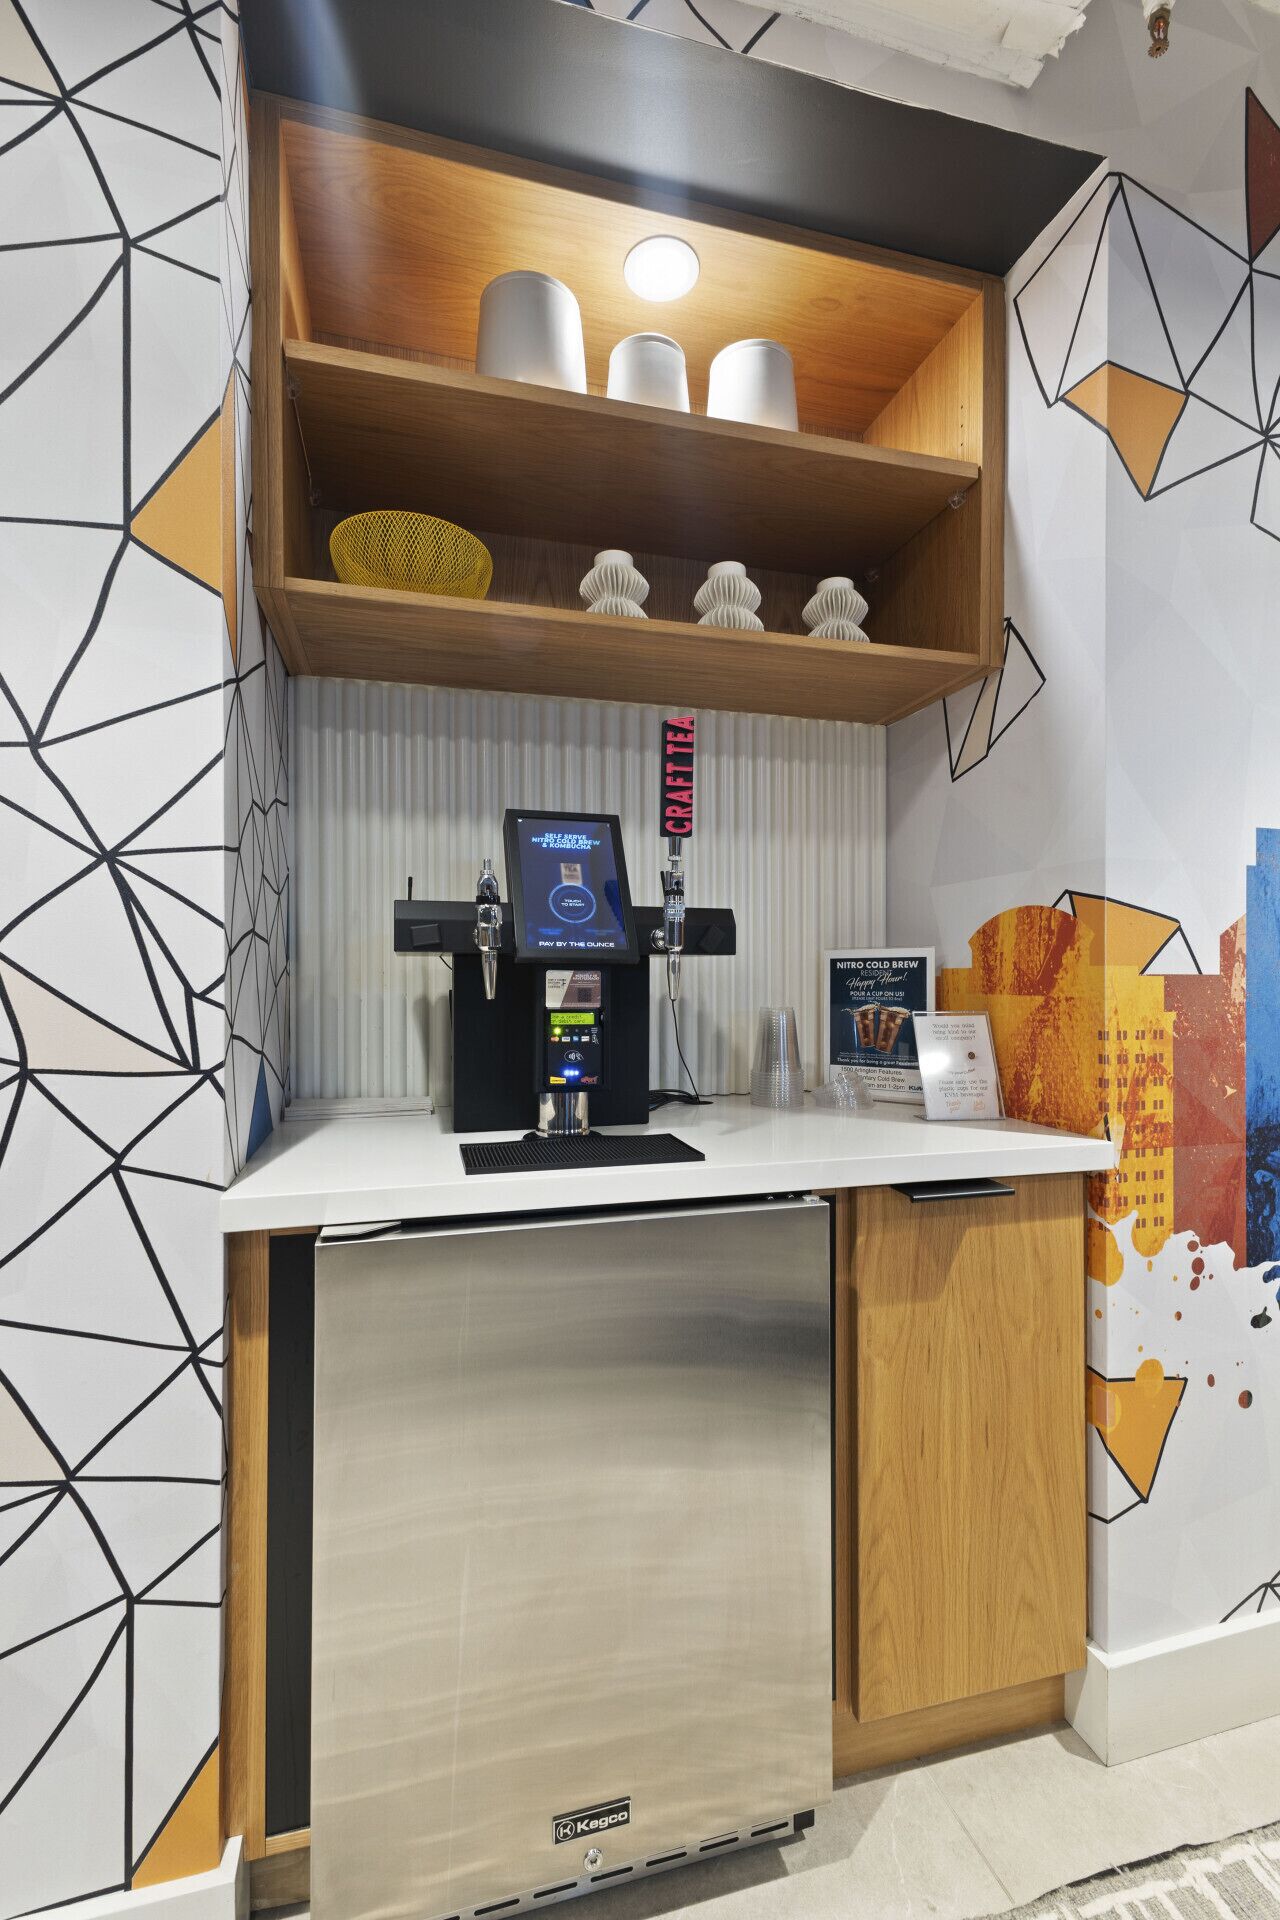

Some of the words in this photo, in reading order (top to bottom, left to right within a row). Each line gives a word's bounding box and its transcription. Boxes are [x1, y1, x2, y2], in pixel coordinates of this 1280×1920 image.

[666, 716, 695, 755] TEA
[665, 762, 693, 834] CRAFT
[549, 842, 591, 850] KOMBUCHA
[836, 961, 864, 969] NITRO
[892, 960, 919, 968] BREW
[860, 969, 892, 977] RESIDENT
[846, 977, 876, 990] Happy
[877, 972, 908, 985] Hour!
[576, 1811, 628, 1834] Kegco
